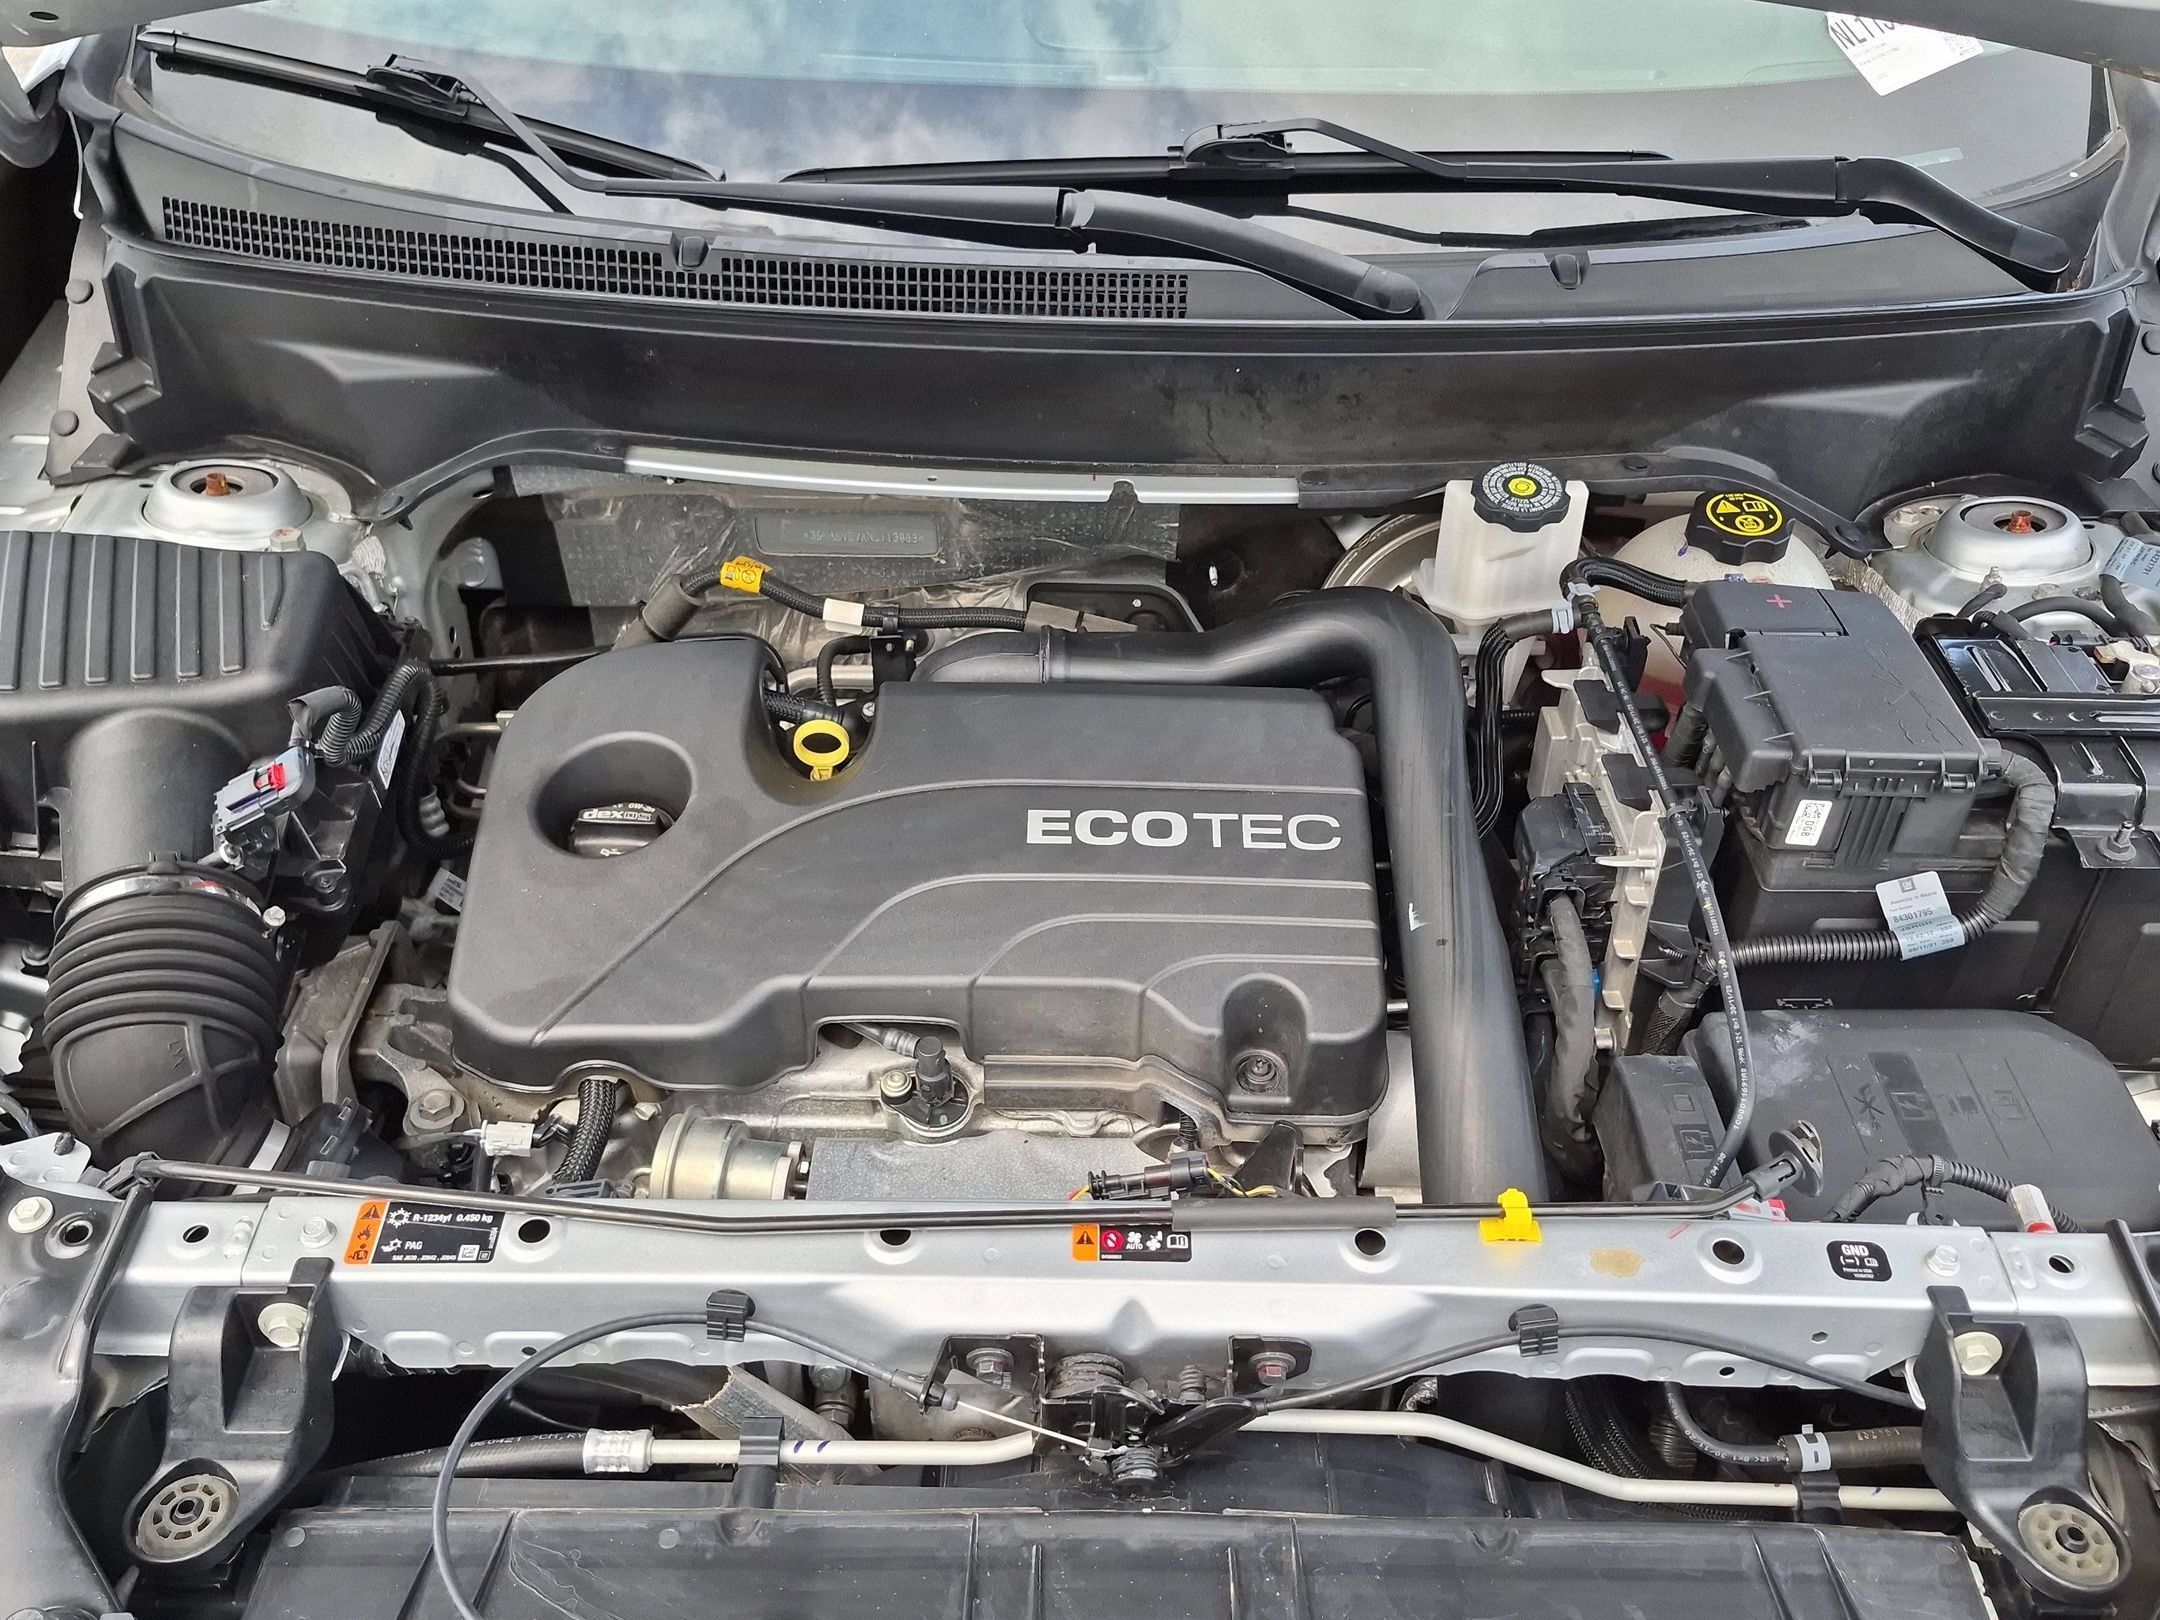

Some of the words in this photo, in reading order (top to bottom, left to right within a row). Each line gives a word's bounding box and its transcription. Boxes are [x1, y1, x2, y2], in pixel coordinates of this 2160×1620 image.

[582, 808, 652, 821] dexos
[1026, 809, 1342, 851] ECOTEC
[1893, 907, 1933, 923] 84301795
[412, 1213, 452, 1223] R-1234yf
[456, 1213, 481, 1222] 0.450
[481, 1214, 494, 1223] kg
[404, 1241, 423, 1250] PAG
[1841, 1244, 1869, 1257] GND
